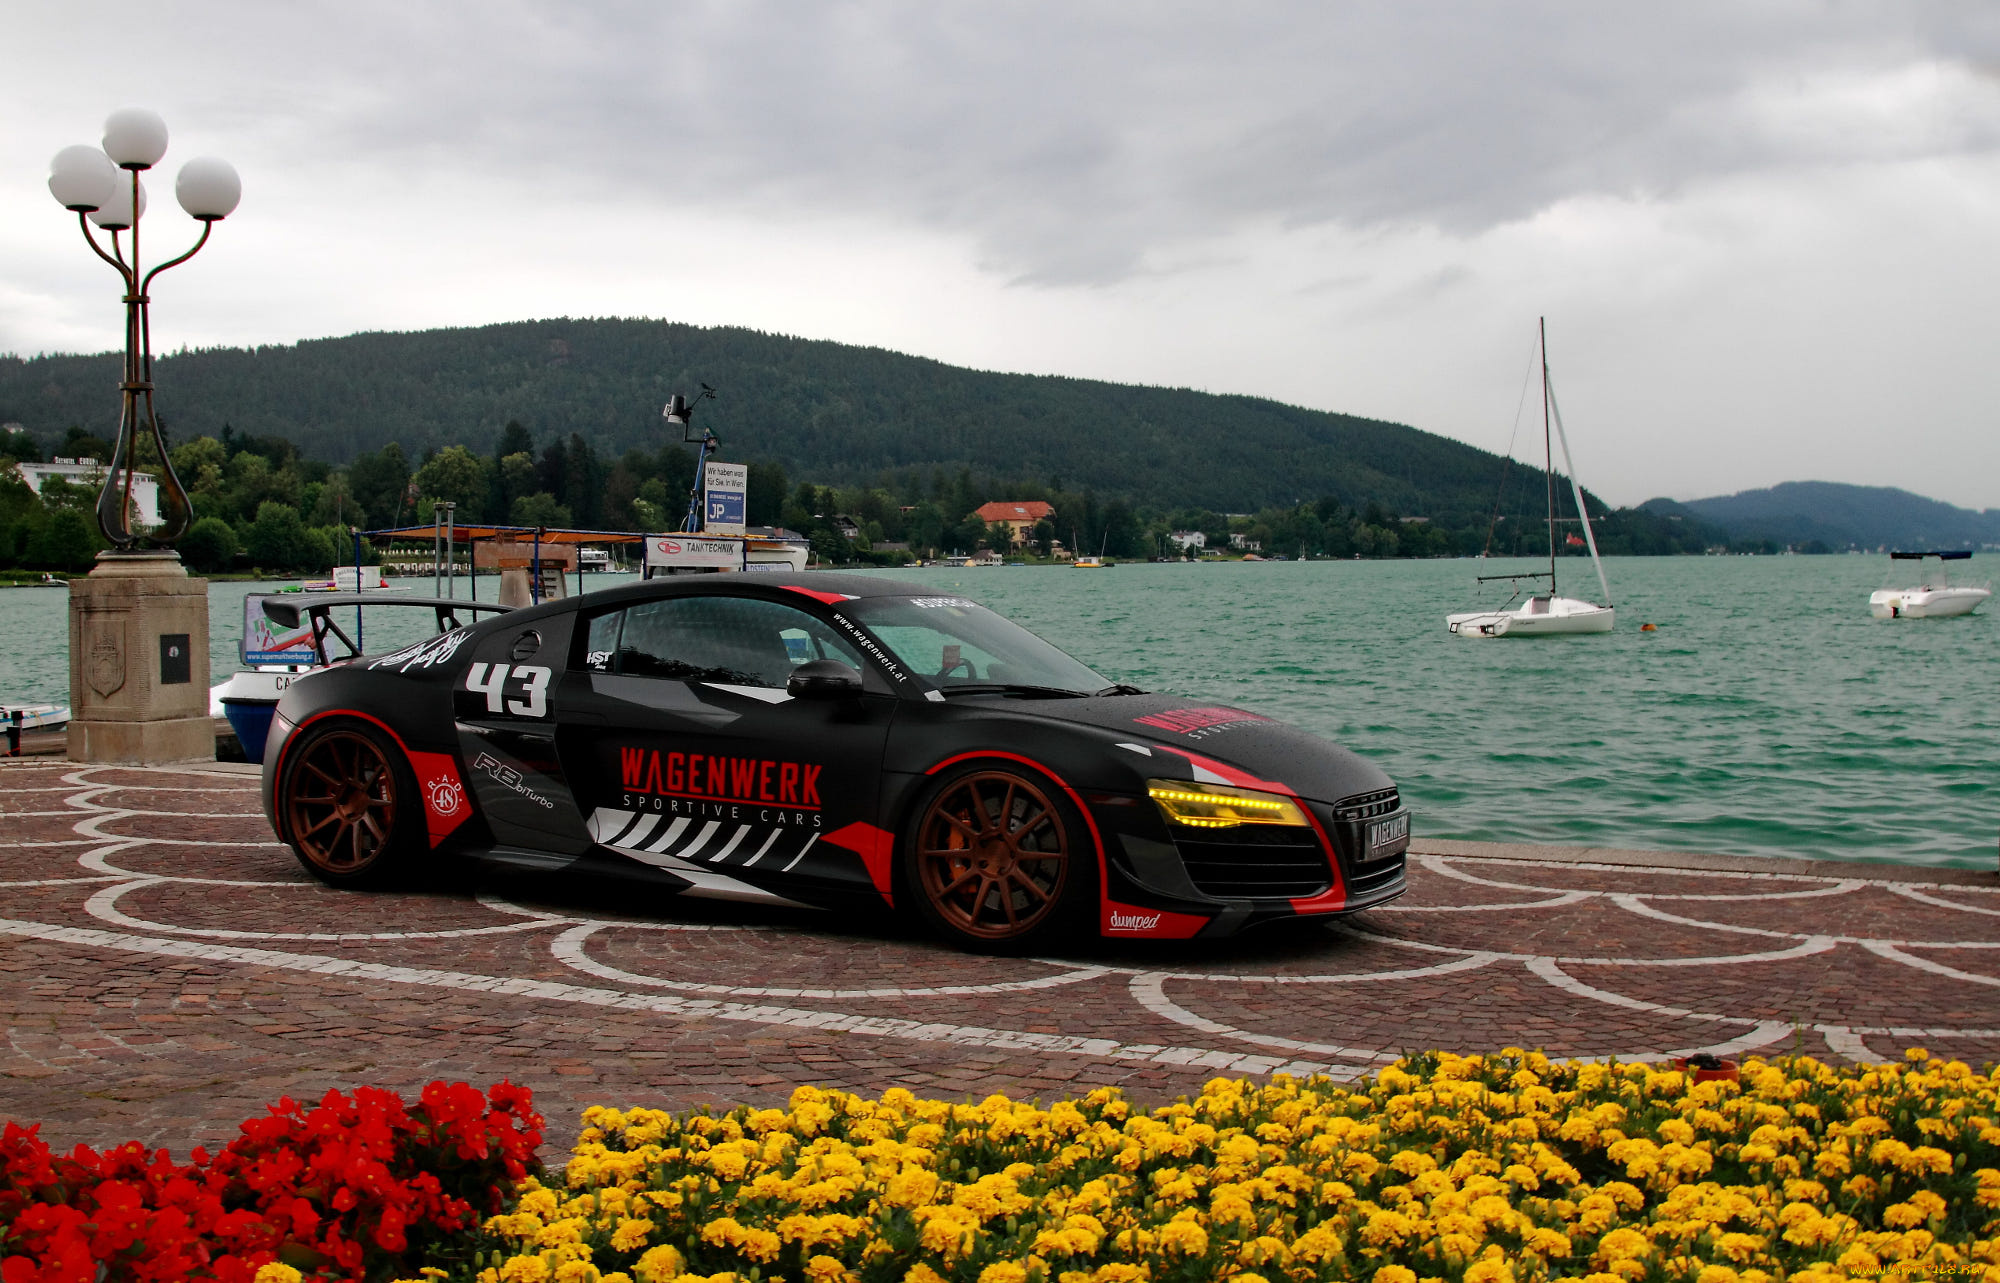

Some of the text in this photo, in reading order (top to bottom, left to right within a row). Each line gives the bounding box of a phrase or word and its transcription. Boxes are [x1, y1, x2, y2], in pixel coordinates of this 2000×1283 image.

[707, 467, 716, 475] Wir
[718, 468, 733, 477] haben
[709, 503, 725, 519] JP
[686, 542, 735, 554] TANKTECHNIK
[586, 650, 613, 663] HST
[832, 611, 907, 684] www.wagenwerk.at
[465, 662, 552, 718] 43
[473, 751, 524, 790] R8
[621, 746, 822, 808] WAGENWERK
[435, 788, 454, 809] 48
[624, 793, 822, 828] SPORTIVE CARS
[1110, 909, 1161, 930] dumped
